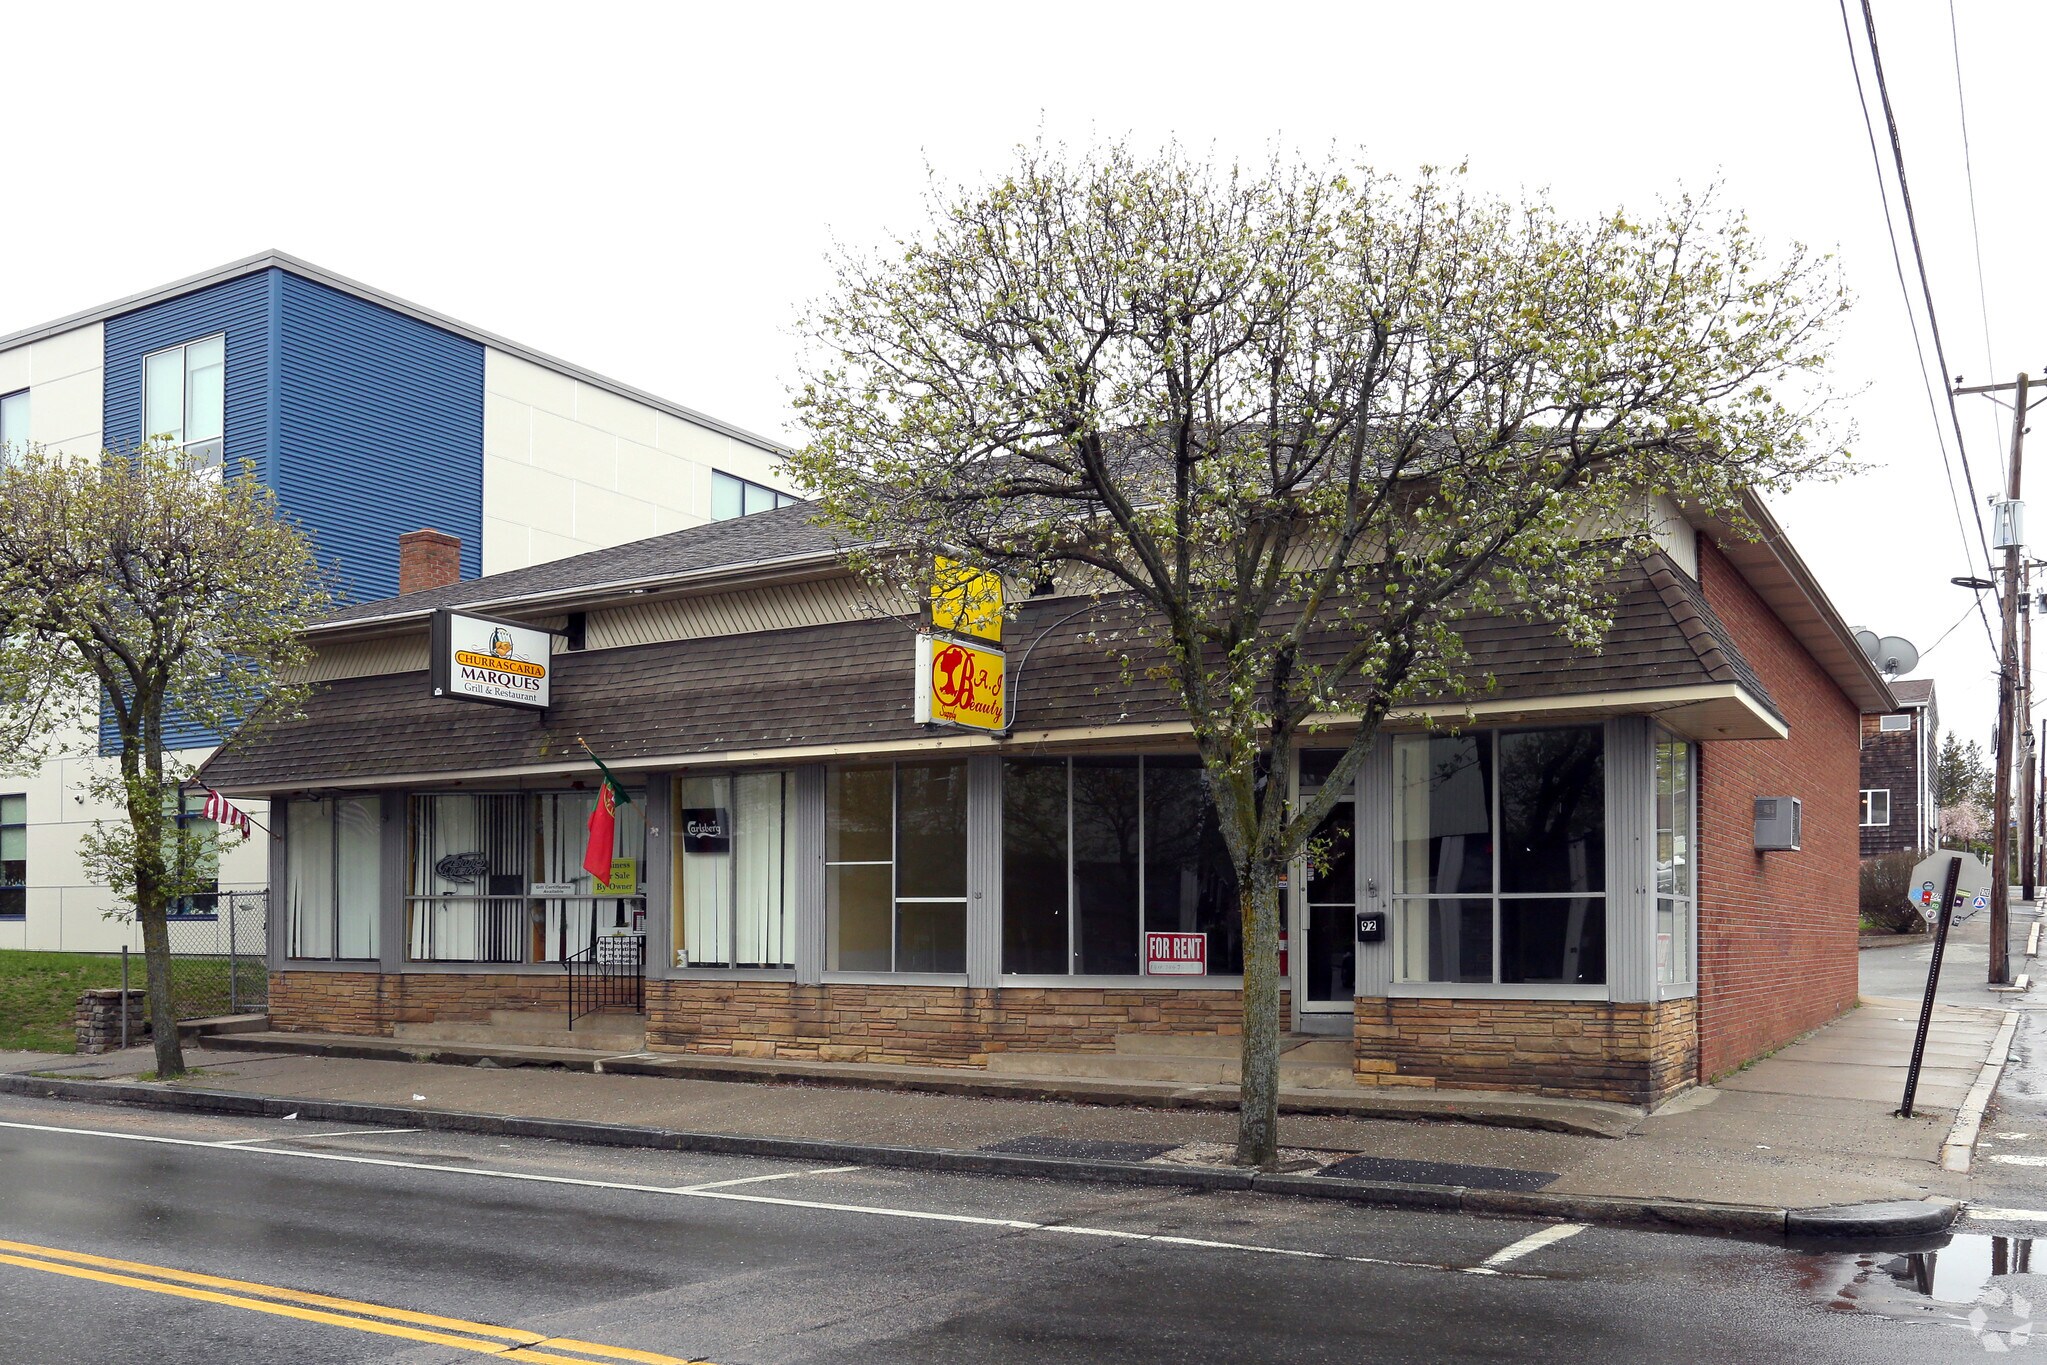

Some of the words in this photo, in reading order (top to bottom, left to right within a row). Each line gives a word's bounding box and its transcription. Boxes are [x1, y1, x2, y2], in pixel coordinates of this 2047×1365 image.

[457, 653, 542, 676] CHURRASCARIA
[461, 666, 540, 691] MARQUES
[464, 682, 483, 694] Grill
[485, 685, 492, 695] &
[495, 687, 537, 702] Restaurant
[687, 820, 721, 839] Carlsberg
[612, 861, 631, 869] iness
[614, 871, 631, 880] Sale
[596, 883, 606, 893] By
[609, 882, 633, 891] Owner
[1362, 921, 1375, 931] 92
[1149, 937, 1170, 959] FOR
[1173, 937, 1203, 959] RENT
